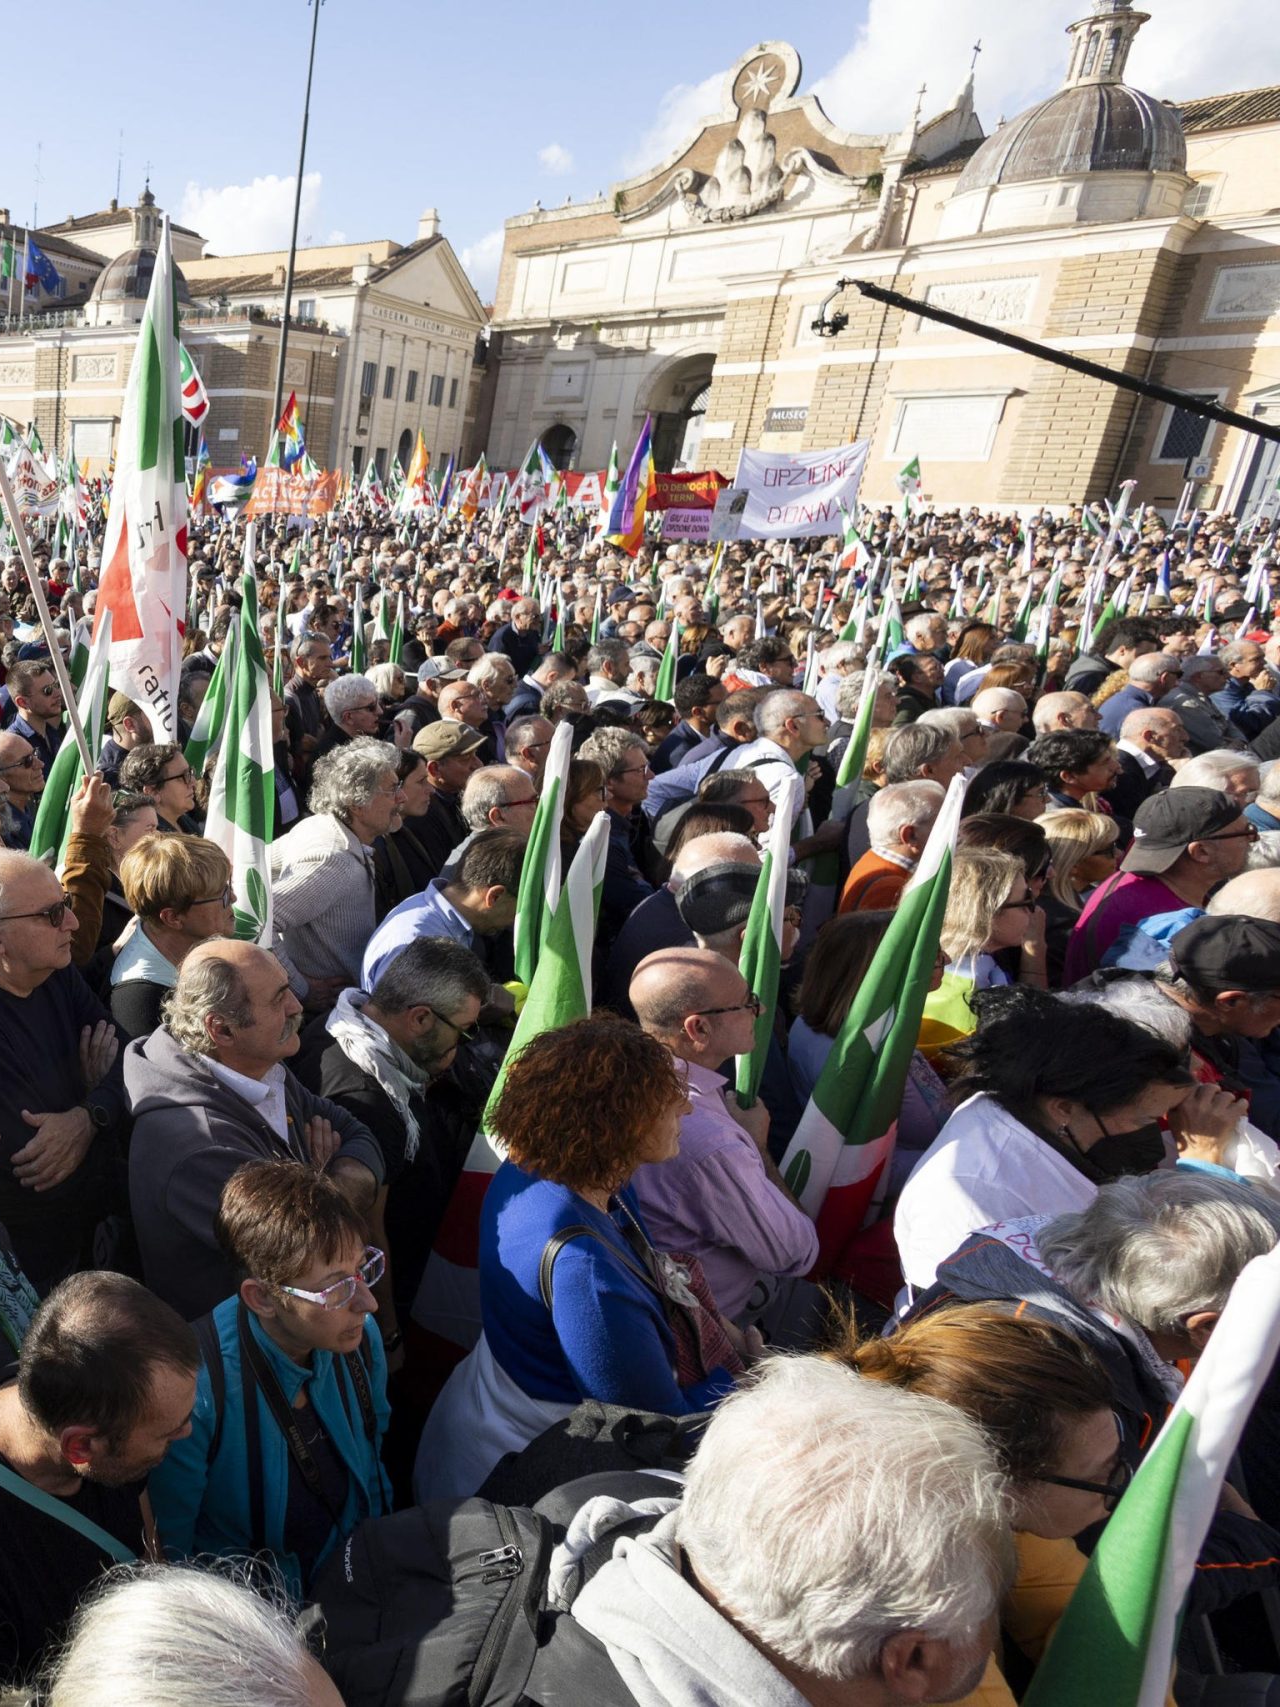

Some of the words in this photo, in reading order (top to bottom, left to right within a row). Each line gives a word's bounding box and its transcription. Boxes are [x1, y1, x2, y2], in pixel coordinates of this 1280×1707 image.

[372, 306, 408, 324] CASERMA
[771, 408, 808, 420] MUSEO
[763, 456, 857, 487] OPZIONE
[288, 1425, 310, 1460] Nikon
